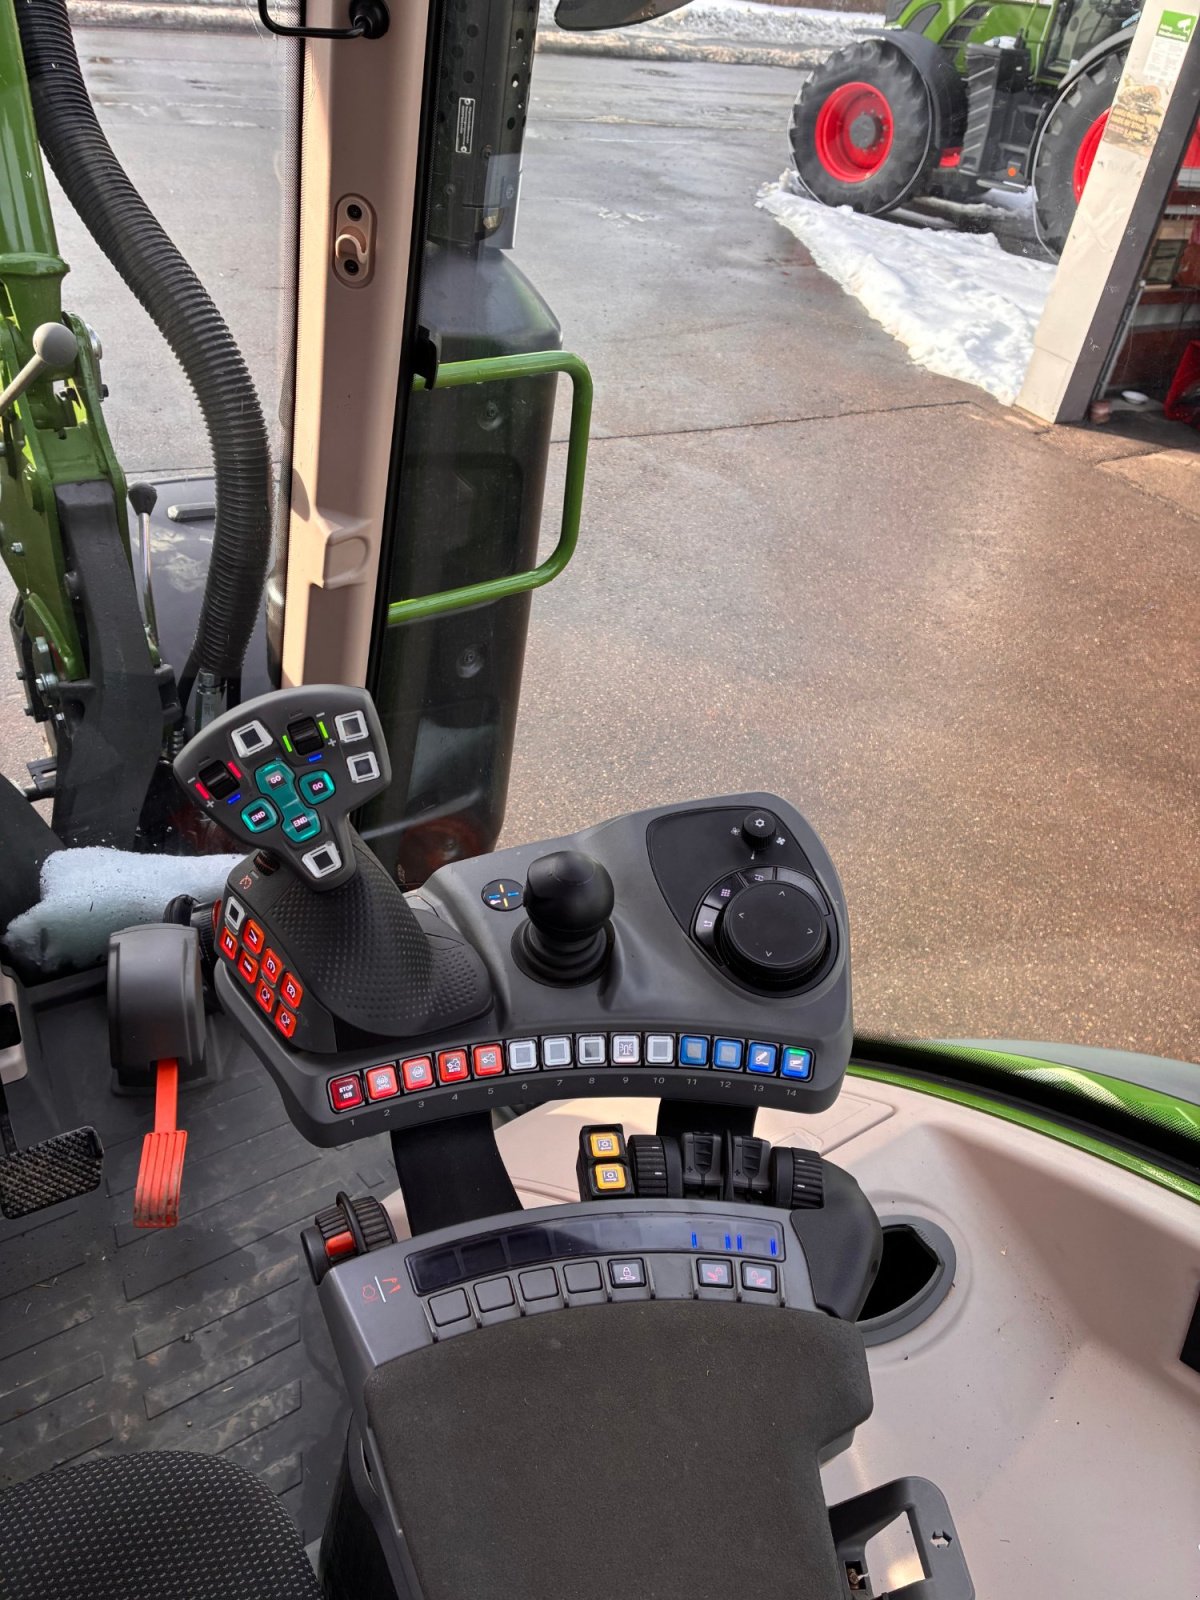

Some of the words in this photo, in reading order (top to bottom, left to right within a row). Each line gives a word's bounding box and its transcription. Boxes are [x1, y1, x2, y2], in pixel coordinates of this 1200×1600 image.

[270, 775, 282, 784] GO
[312, 782, 324, 791] GO
[251, 811, 266, 822] END
[293, 816, 308, 827] END
[339, 1084, 354, 1093] STOP
[383, 1109, 391, 1117] 2
[418, 1100, 425, 1108] 3
[487, 1087, 494, 1095] 5
[557, 1079, 563, 1087] 7
[622, 1076, 629, 1084] 9
[753, 1084, 765, 1092] 13
[786, 1088, 797, 1097] 14
